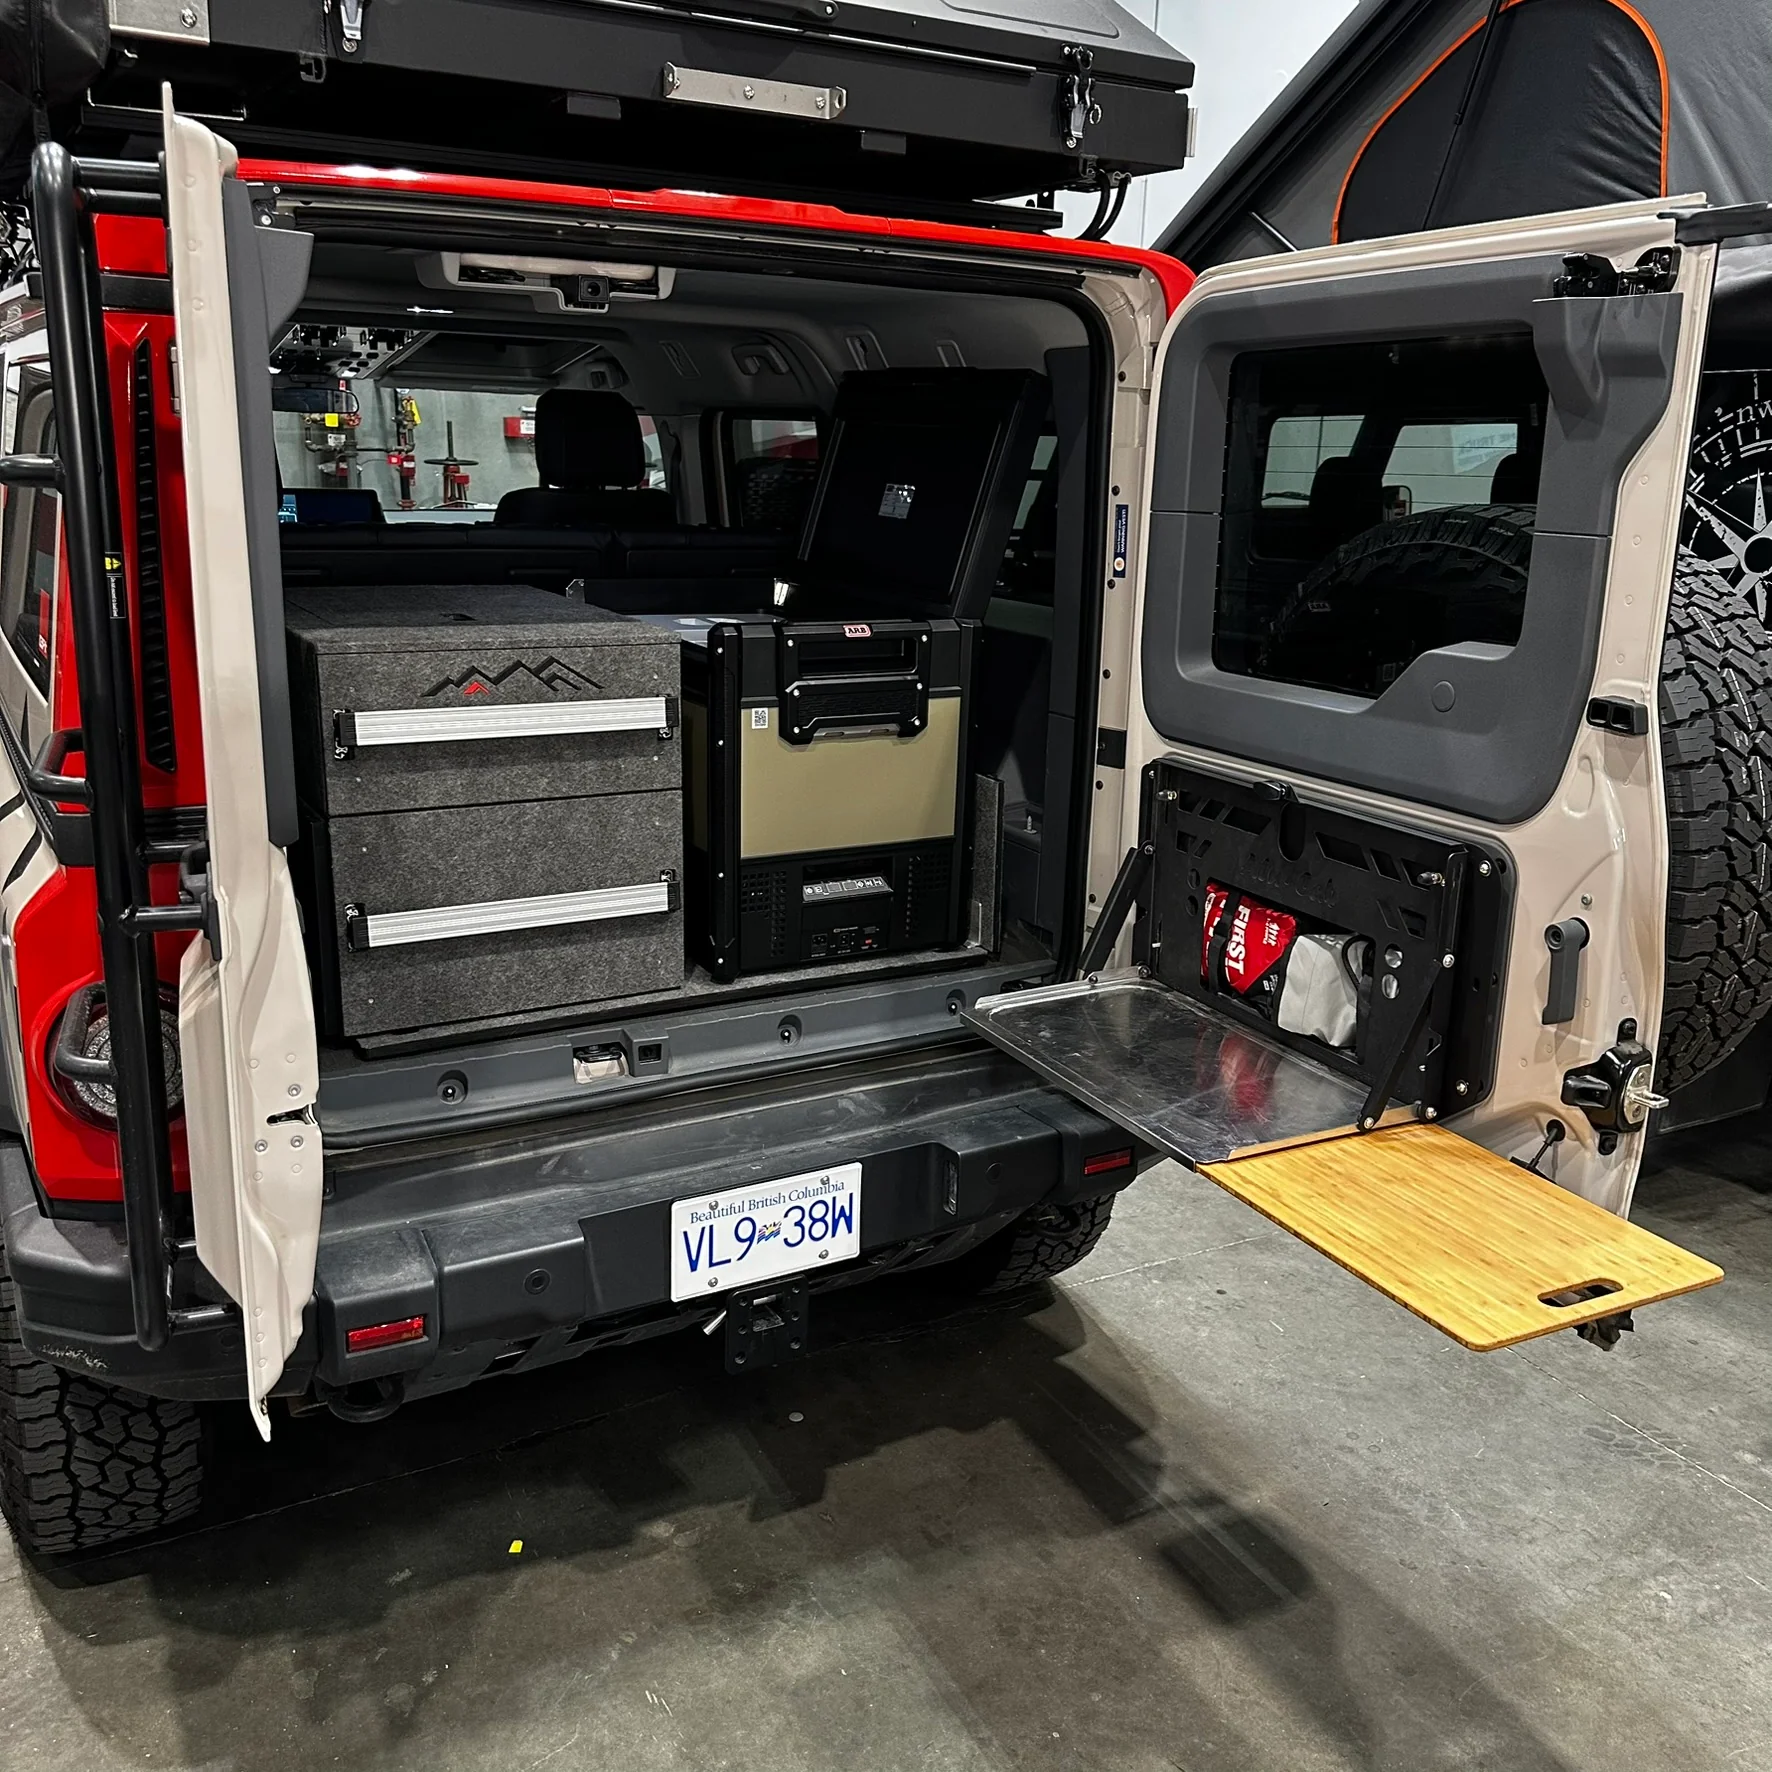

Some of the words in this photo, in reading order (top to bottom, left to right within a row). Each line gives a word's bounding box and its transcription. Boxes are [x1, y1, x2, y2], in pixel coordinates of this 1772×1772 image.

[1226, 904, 1251, 976] FIRST
[683, 1216, 757, 1273] VL9
[783, 1192, 854, 1248] 38W
[690, 1203, 746, 1225] Beautiful
[748, 1193, 786, 1211] British
[788, 1180, 845, 1202] Columbia
